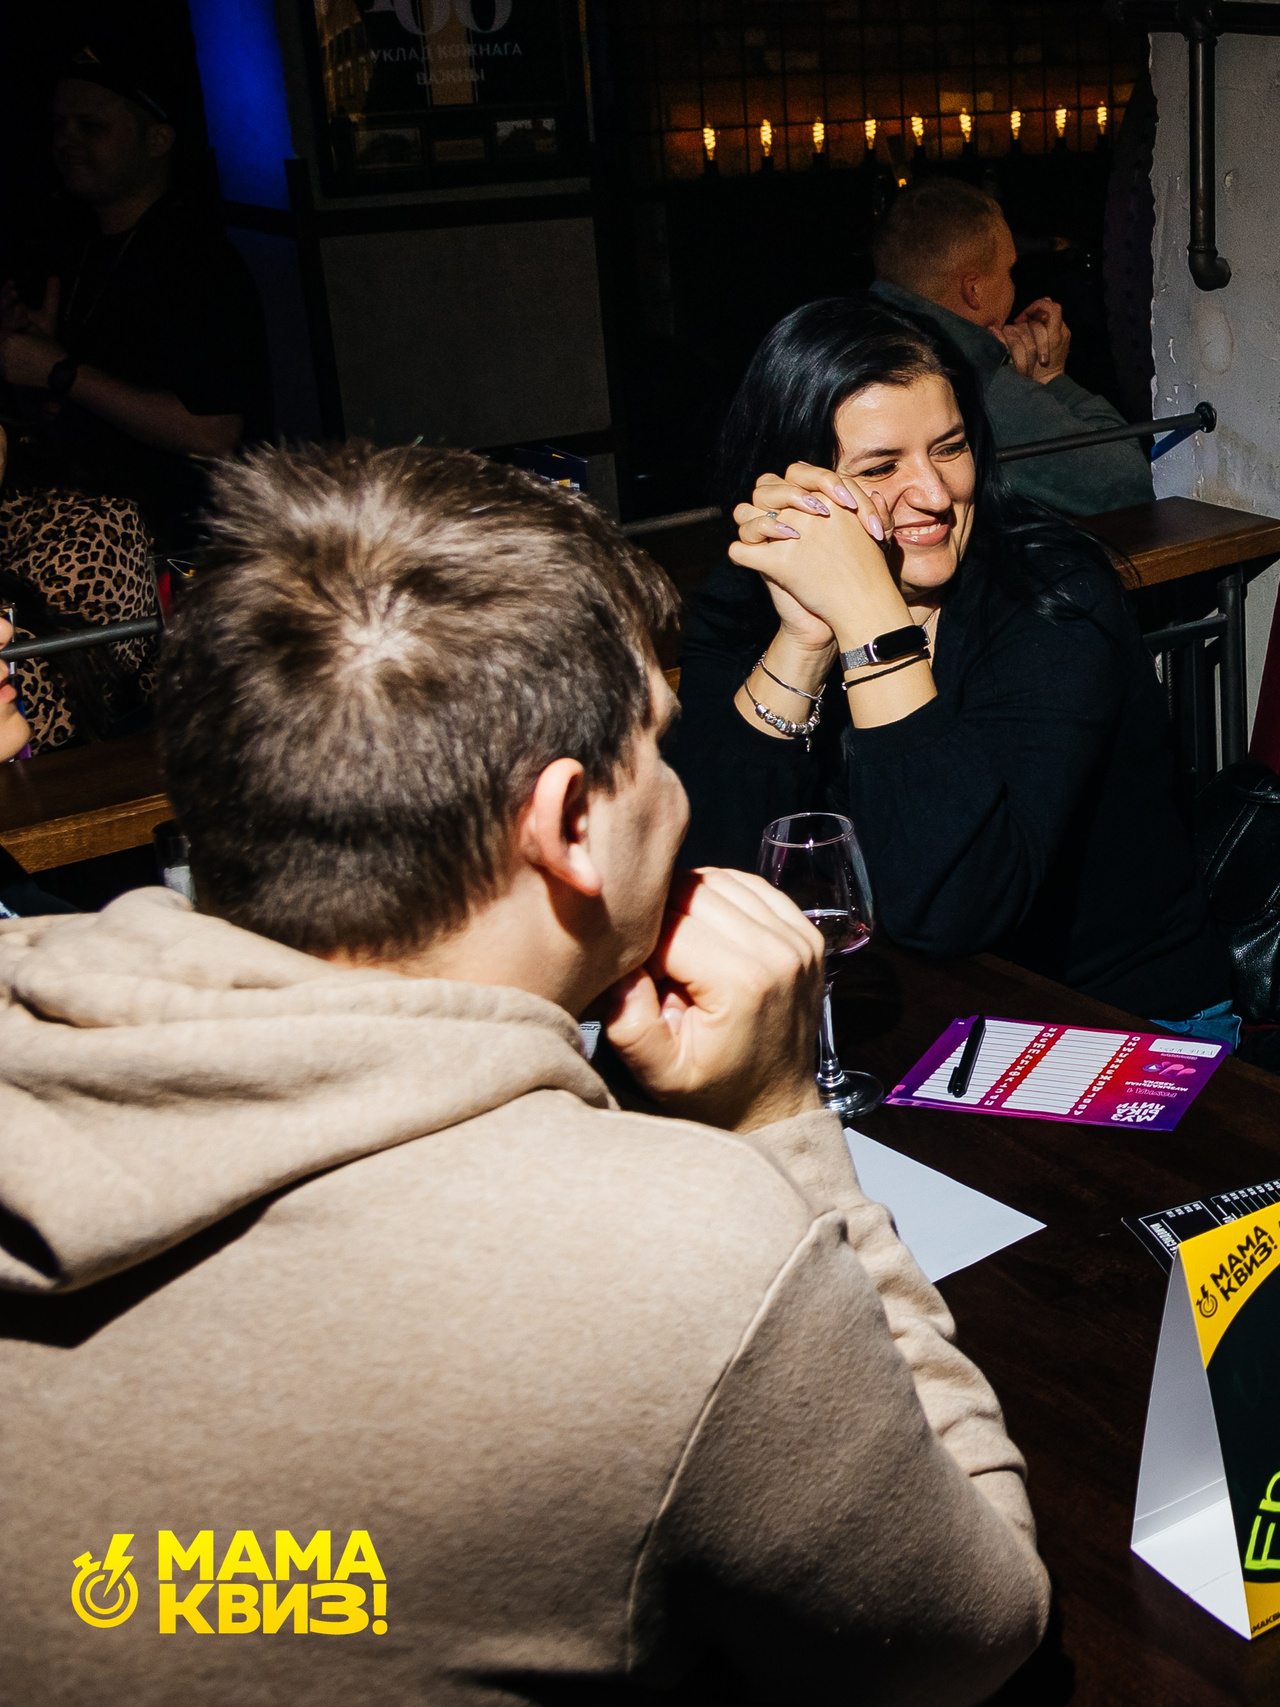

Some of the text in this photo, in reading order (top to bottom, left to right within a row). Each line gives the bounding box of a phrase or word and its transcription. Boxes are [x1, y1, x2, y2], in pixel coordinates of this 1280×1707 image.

[1111, 1111, 1156, 1122] МУЗ
[1117, 1105, 1159, 1118] ЫКА
[1210, 1225, 1269, 1288] МАМА
[1219, 1235, 1278, 1302] КВИЗ!
